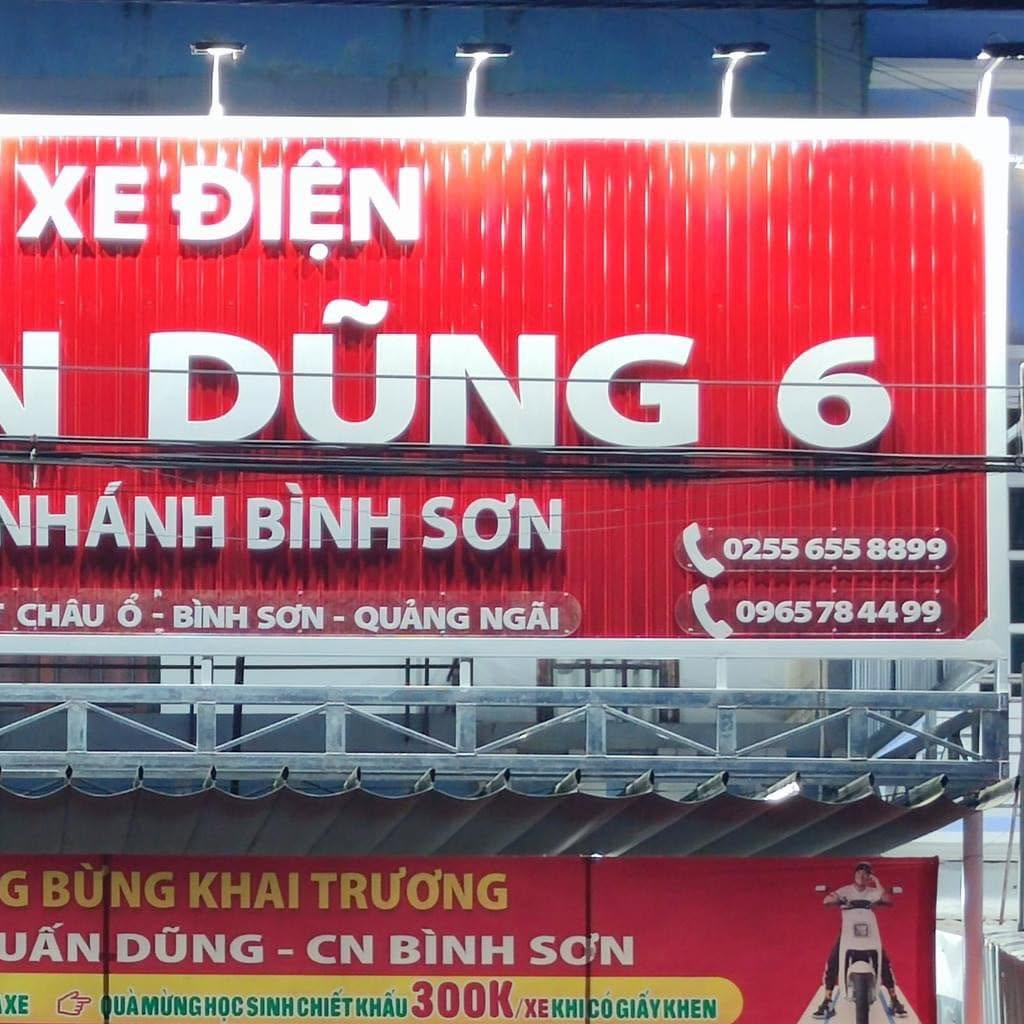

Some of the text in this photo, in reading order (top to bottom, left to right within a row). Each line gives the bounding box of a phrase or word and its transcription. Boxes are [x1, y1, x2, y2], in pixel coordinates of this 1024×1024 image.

[16, 149, 420, 260] XE ĐIỆN
[148, 299, 699, 449] DŨNG
[777, 336, 892, 450] 6
[246, 483, 400, 551] BÌNH
[422, 494, 562, 552] SƠN
[723, 537, 947, 561] 0255 655 8899
[17, 598, 104, 627] CHÂU
[173, 599, 248, 629] BÌNH
[257, 603, 324, 630] SƠN
[354, 598, 469, 632] QUẢNG
[480, 601, 559, 631] NGÃI
[735, 600, 812, 624] 0965
[43, 863, 175, 909] BÙNG
[189, 871, 299, 910] KHAI
[311, 867, 508, 911] TRƯƠNG
[116, 926, 264, 964] DŨNG
[307, 933, 376, 965] CN
[390, 930, 514, 966] BÌNH
[529, 933, 634, 967] SƠN
[4, 993, 29, 1015] XE
[141, 987, 202, 1018] MỪNG
[206, 995, 245, 1022] HỌC
[247, 995, 294, 1018] SINH
[297, 987, 353, 1018] CHIẾT
[355, 988, 408, 1019] KHẤU
[551, 998, 584, 1020] KHI
[590, 991, 613, 1020] CÓ
[616, 990, 662, 1020] GIẤY
[663, 998, 717, 1020] KHEN
